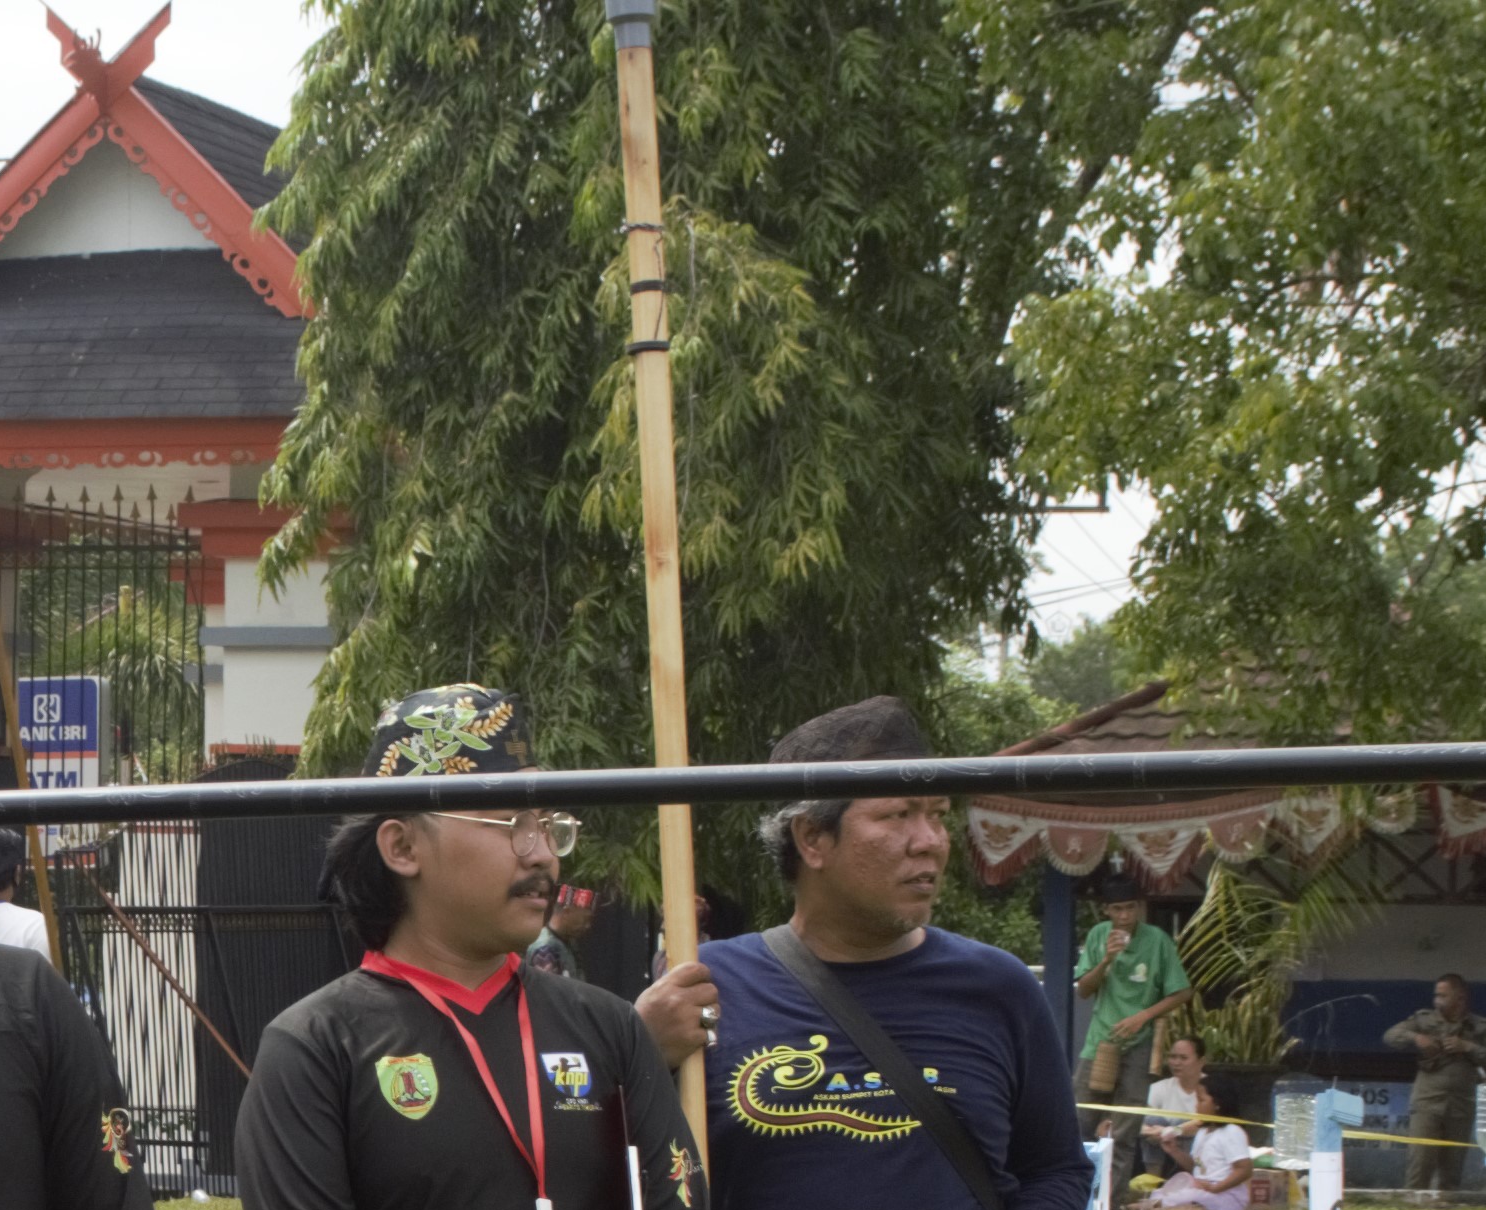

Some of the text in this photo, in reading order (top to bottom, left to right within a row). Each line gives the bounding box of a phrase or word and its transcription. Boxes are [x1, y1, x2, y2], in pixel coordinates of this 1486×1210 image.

[19, 725, 86, 742] ANK BRI
[554, 1059, 589, 1098] knpi
